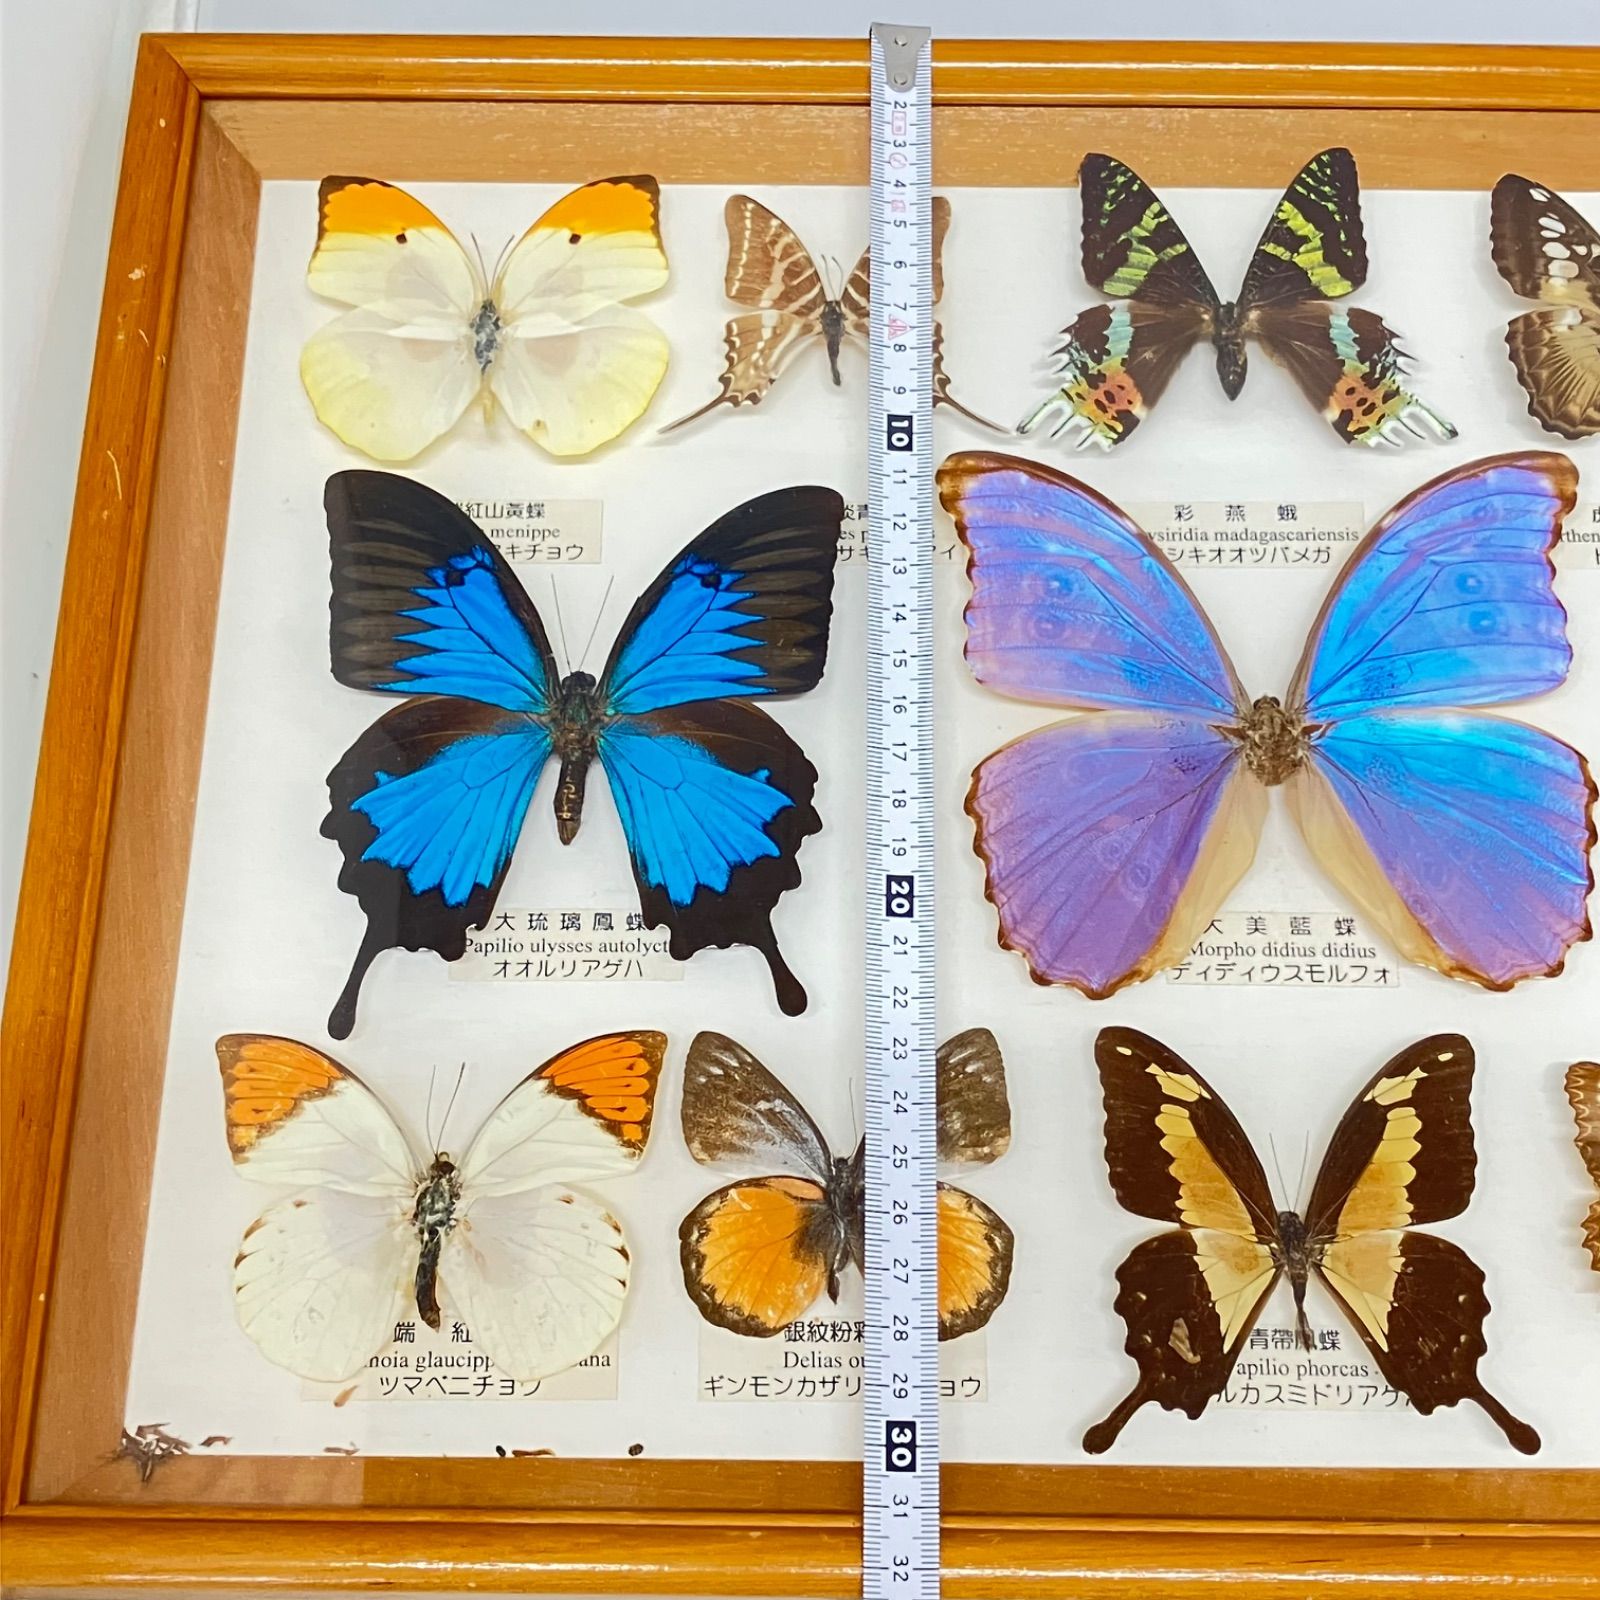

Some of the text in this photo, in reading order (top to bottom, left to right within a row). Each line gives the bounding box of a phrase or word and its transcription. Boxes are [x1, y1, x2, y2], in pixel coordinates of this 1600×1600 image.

[894, 100, 907, 109] 2
[893, 139, 907, 148] 3
[893, 179, 907, 188] 4
[893, 219, 907, 229] 5
[893, 260, 907, 269] 6
[893, 302, 907, 311] 7
[893, 343, 907, 353] 8
[893, 386, 907, 395] 9
[891, 420, 909, 447] 10
[893, 469, 907, 484] 11
[893, 512, 907, 531] 12
[490, 524, 560, 541] menippe
[1214, 527, 1359, 545] madagascariensis
[495, 544, 583, 560] キチョウ
[893, 557, 907, 575] 13
[892, 603, 907, 623] 14
[893, 649, 907, 668] 15
[893, 695, 907, 714] 16
[892, 742, 907, 761] 17
[892, 789, 907, 808] 18
[892, 837, 907, 857] 19
[891, 881, 910, 914] 20
[465, 938, 524, 957] Papilio
[530, 938, 592, 957] ulysses
[893, 935, 908, 955] 21
[1191, 941, 1376, 960] Morpho didius didius
[493, 959, 643, 978] オオルリアゲハ
[893, 986, 908, 1009] 22
[893, 1037, 908, 1060] 23
[893, 1090, 908, 1114] 24
[893, 1145, 908, 1169] 25
[893, 1200, 908, 1225] 26
[893, 1258, 909, 1284] 27
[893, 1315, 909, 1341] 28
[784, 1351, 842, 1369] Delias
[1297, 1359, 1369, 1380] phorcas
[893, 1373, 909, 1399] 29
[891, 1427, 912, 1467] 30
[893, 1494, 909, 1518] 31
[893, 1555, 909, 1582] 32
